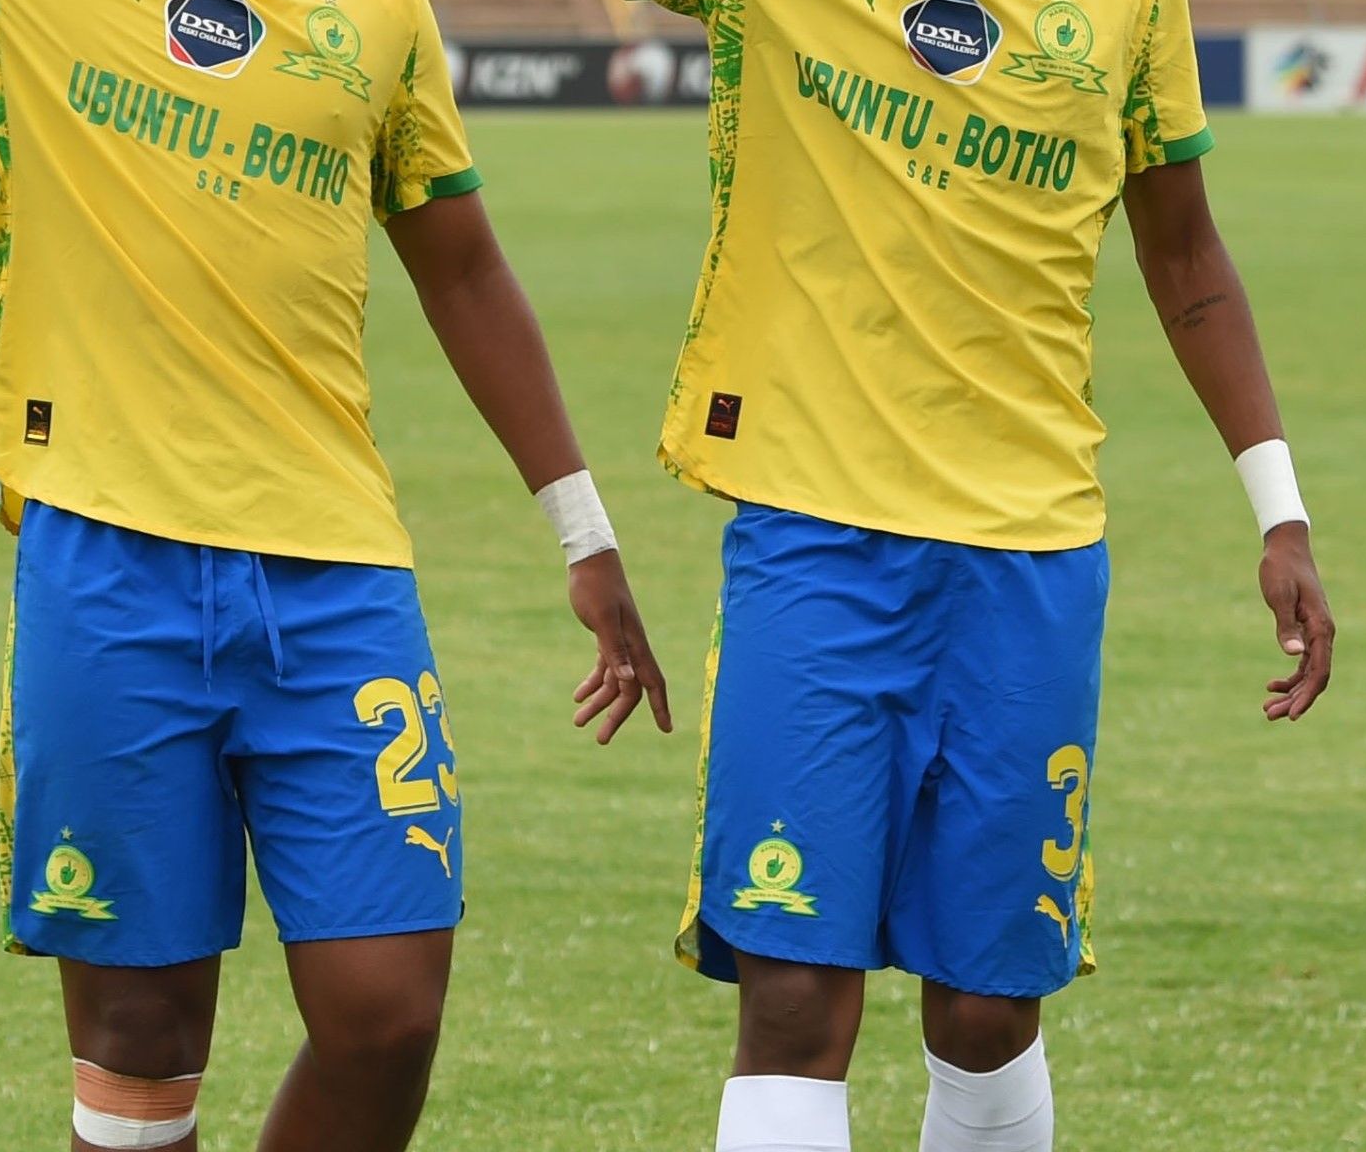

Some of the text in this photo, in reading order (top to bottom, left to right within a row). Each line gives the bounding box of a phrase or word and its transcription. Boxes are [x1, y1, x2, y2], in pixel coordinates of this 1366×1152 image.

[180, 12, 246, 41] DStv
[198, 31, 243, 51] CHALLENGE
[916, 22, 983, 46] DStv
[936, 40, 981, 56] CHALLENGE
[66, 61, 220, 160] UBUNTU
[242, 122, 349, 206] BOTHO
[794, 51, 935, 150] UBUNTU
[954, 113, 1078, 192] BOTHO
[196, 169, 242, 201] S & E
[906, 159, 951, 191] S & E
[1041, 744, 1089, 883] 3
